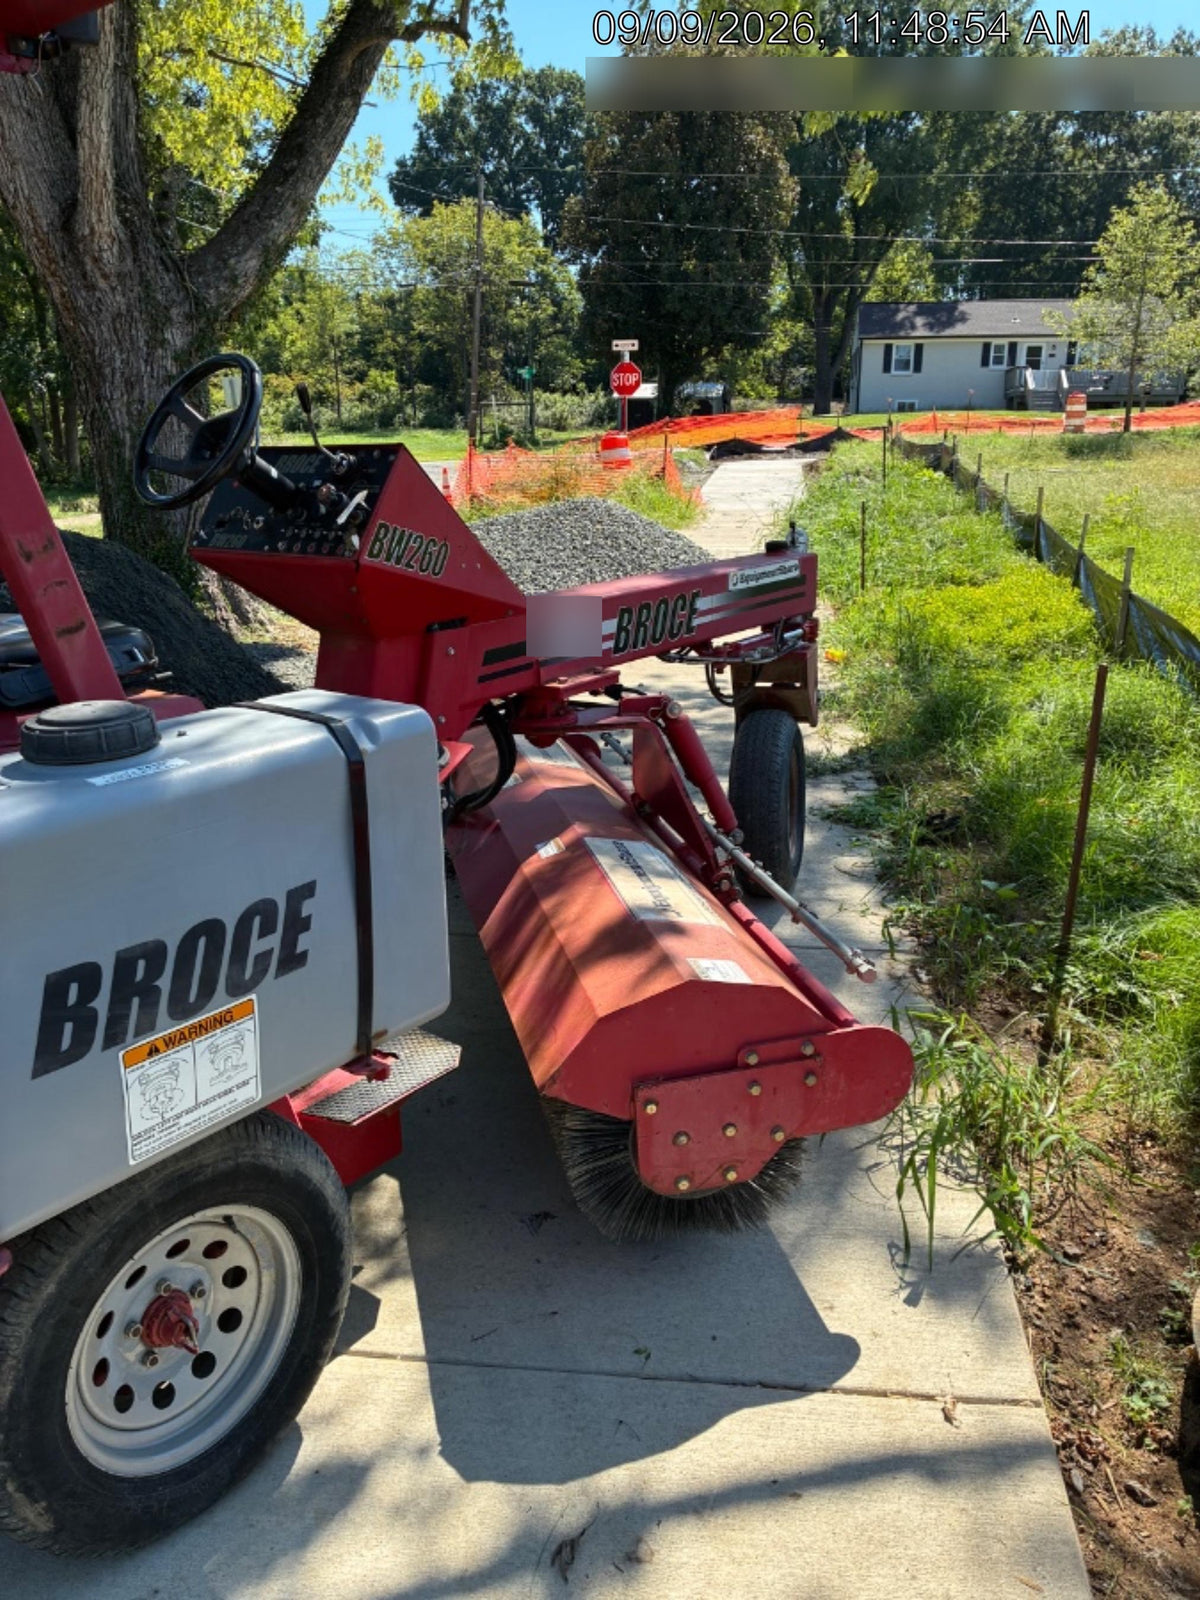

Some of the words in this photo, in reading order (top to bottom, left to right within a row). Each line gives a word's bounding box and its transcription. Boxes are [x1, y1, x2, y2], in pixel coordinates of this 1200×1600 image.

[612, 373, 639, 386] STOP
[366, 521, 449, 578] BW260
[613, 589, 701, 655] BROCE
[31, 879, 317, 1080] BROCE
[163, 1011, 234, 1049] WARNING
